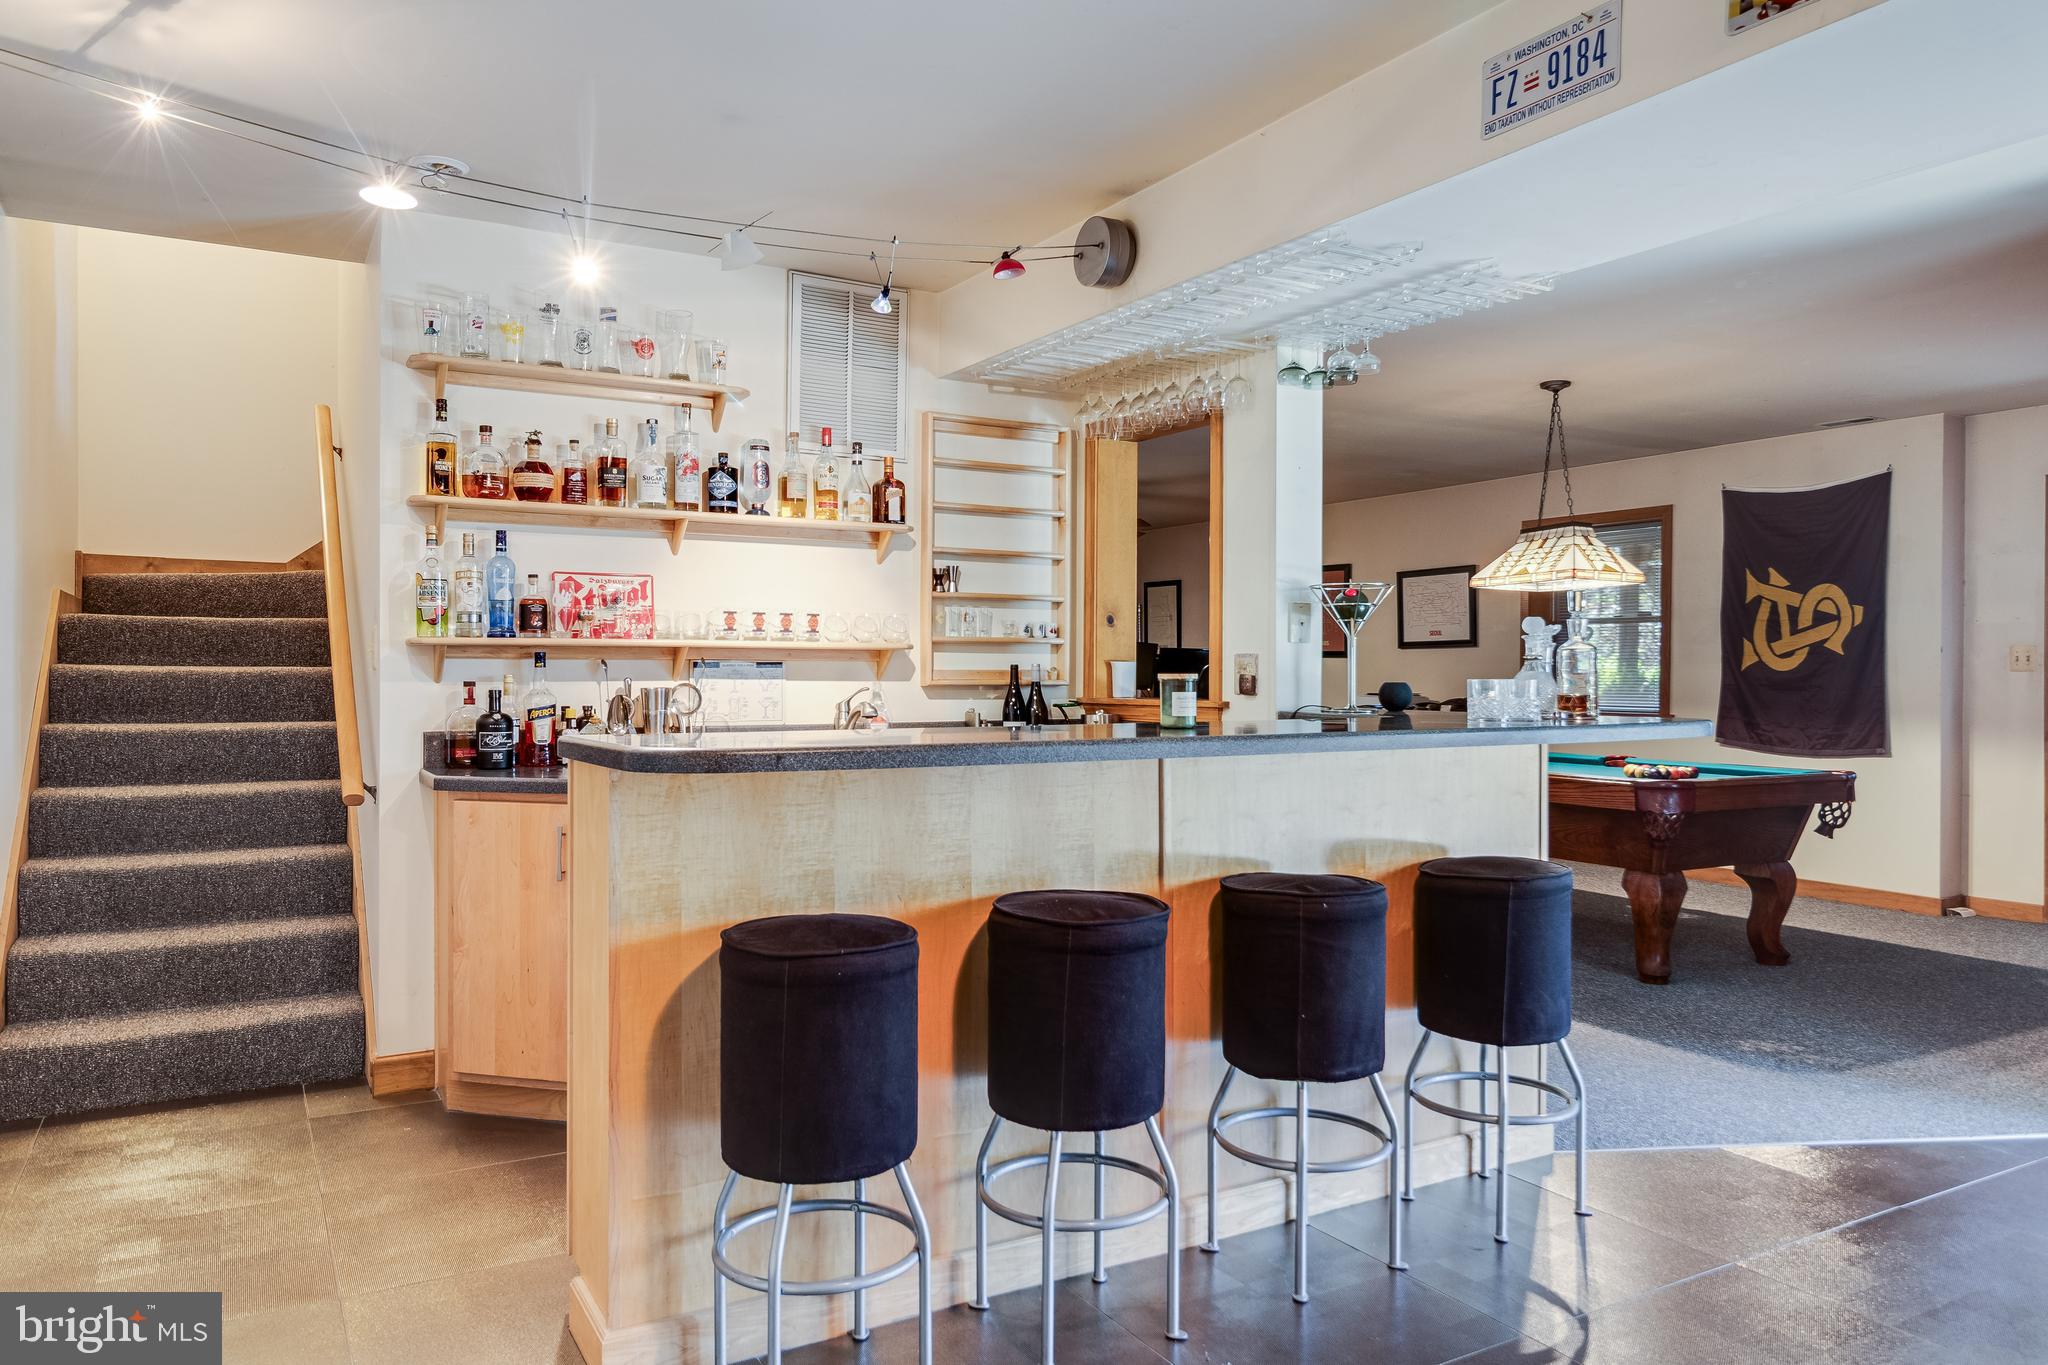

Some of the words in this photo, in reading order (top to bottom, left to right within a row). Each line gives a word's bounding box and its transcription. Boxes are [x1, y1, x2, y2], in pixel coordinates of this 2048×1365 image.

[1514, 28, 1570, 62] WASHINGTON,
[1572, 20, 1584, 35] DC
[1491, 69, 1518, 116] FZ
[1547, 28, 1608, 90] 9184
[1484, 122, 1497, 136] END
[1498, 109, 1526, 129] TAXATION
[1527, 97, 1558, 118] WITHOUT
[1556, 70, 1616, 105] REPRESENTATION
[529, 707, 555, 719] APEROL
